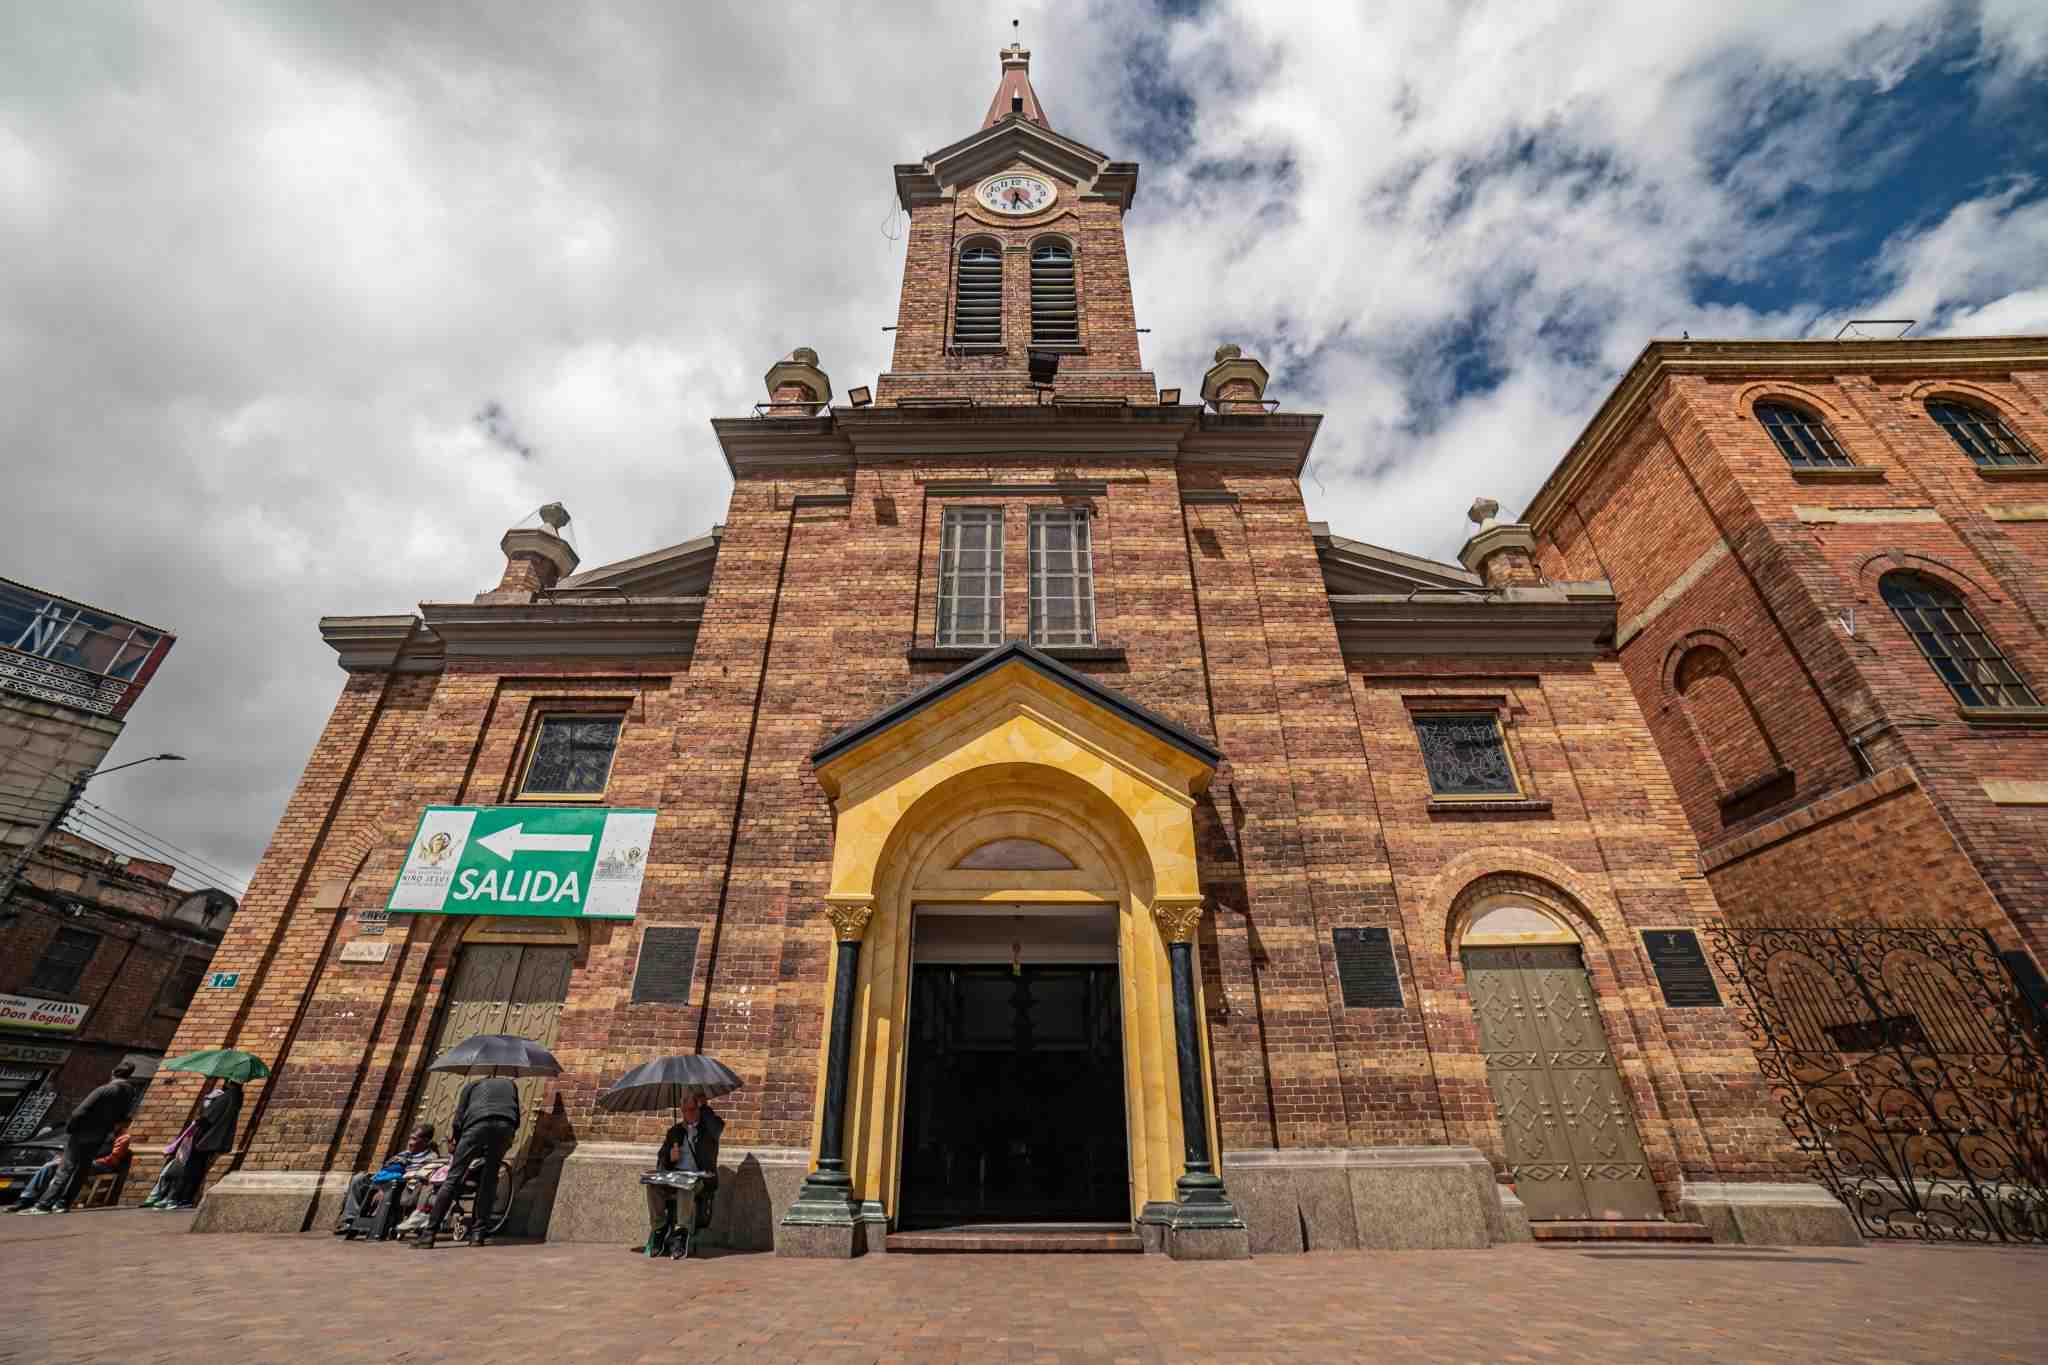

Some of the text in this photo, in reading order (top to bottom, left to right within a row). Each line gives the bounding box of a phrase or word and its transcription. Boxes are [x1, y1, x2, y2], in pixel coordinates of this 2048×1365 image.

[452, 868, 580, 903] SALIDA
[0, 1007, 76, 1025] Don Rogelio
